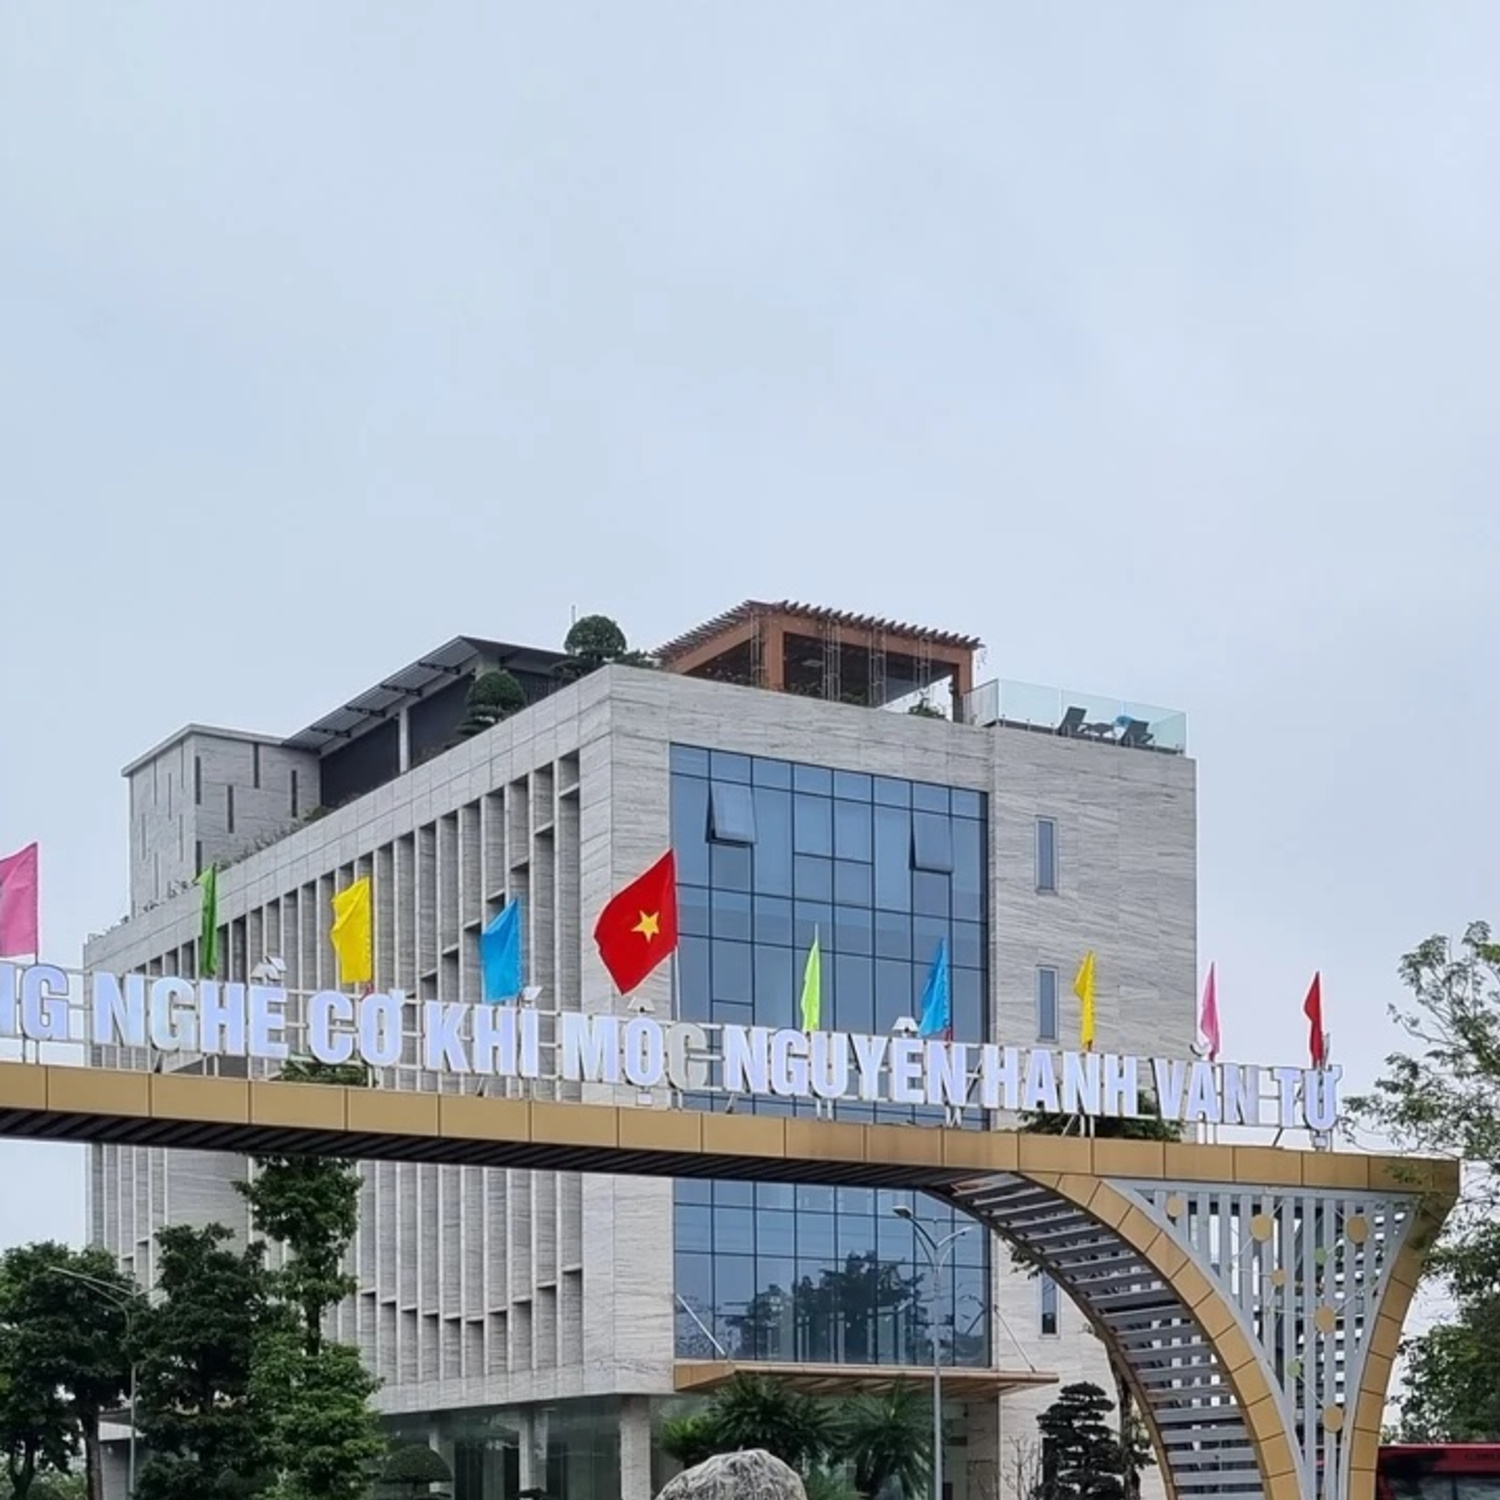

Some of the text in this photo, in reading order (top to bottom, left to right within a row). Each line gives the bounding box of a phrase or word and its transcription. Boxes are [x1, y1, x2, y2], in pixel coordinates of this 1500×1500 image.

[96, 955, 290, 1060] NGHỀ
[307, 987, 406, 1067] CƠ
[424, 985, 543, 1079] KHÍ
[562, 995, 708, 1106] MỘC
[723, 1016, 967, 1107] NGUYÊN
[983, 1043, 1138, 1117] HANH
[1151, 1040, 1260, 1126] VĂN
